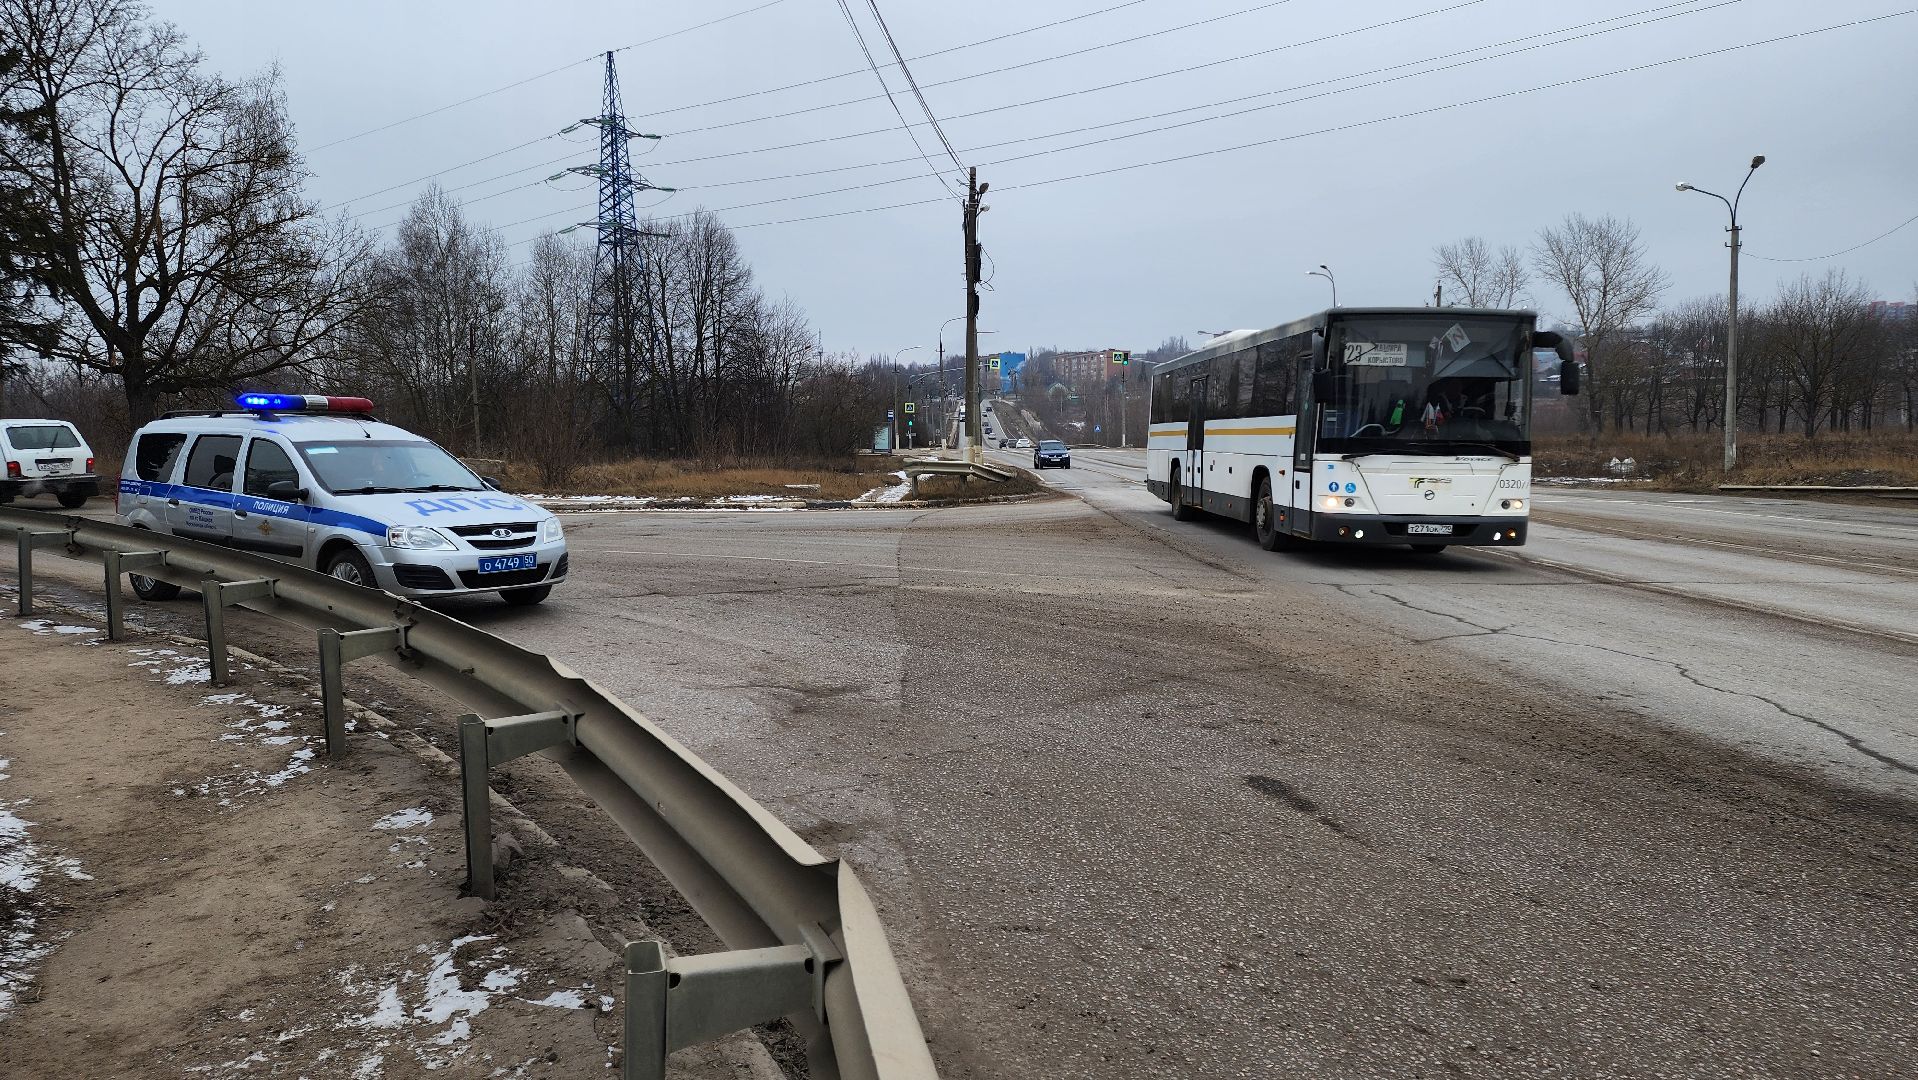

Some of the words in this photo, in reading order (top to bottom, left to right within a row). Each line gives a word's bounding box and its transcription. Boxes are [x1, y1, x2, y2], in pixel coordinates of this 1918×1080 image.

[1346, 344, 1362, 362] 23
[252, 500, 290, 514] ПОЛИЦИЯ
[404, 497, 524, 517] ДПС
[494, 557, 520, 570] 4749
